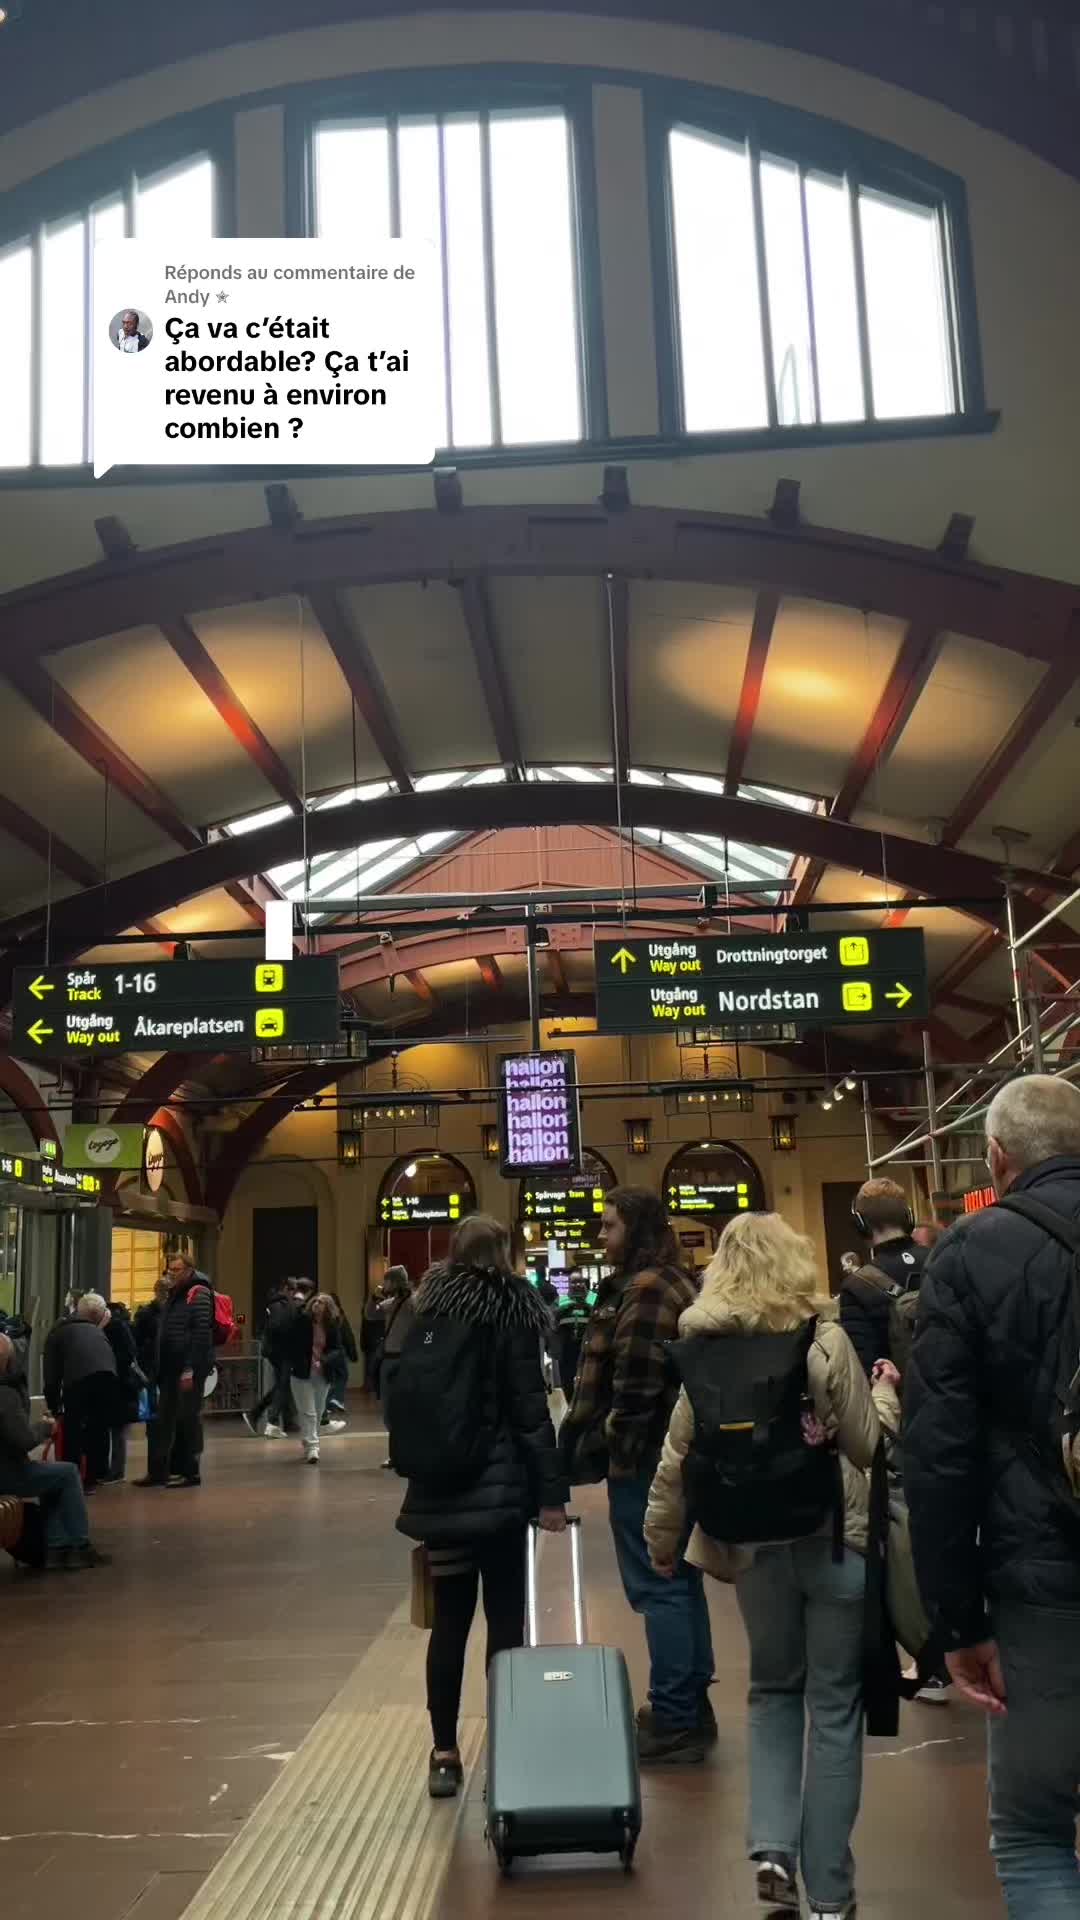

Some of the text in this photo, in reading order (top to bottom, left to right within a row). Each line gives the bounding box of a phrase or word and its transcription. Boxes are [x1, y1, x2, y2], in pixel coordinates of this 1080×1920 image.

[648, 942, 697, 959] Utgång
[716, 946, 828, 965] Drottningtorget
[650, 959, 701, 975] Way out
[67, 971, 96, 987] Spår
[114, 972, 157, 995] 1-16
[67, 987, 102, 1001] Track
[650, 986, 698, 1003] Utgång
[718, 988, 819, 1012] Nordstan
[652, 1004, 706, 1020] Way out
[66, 1014, 113, 1030] Utgång
[134, 1016, 244, 1038] Åkareplatsen
[66, 1030, 120, 1046] Way out
[505, 1059, 565, 1076] hallon
[507, 1094, 567, 1112] hallon
[508, 1111, 568, 1129] hallon
[508, 1128, 569, 1147] hallon
[508, 1143, 569, 1164] hallon
